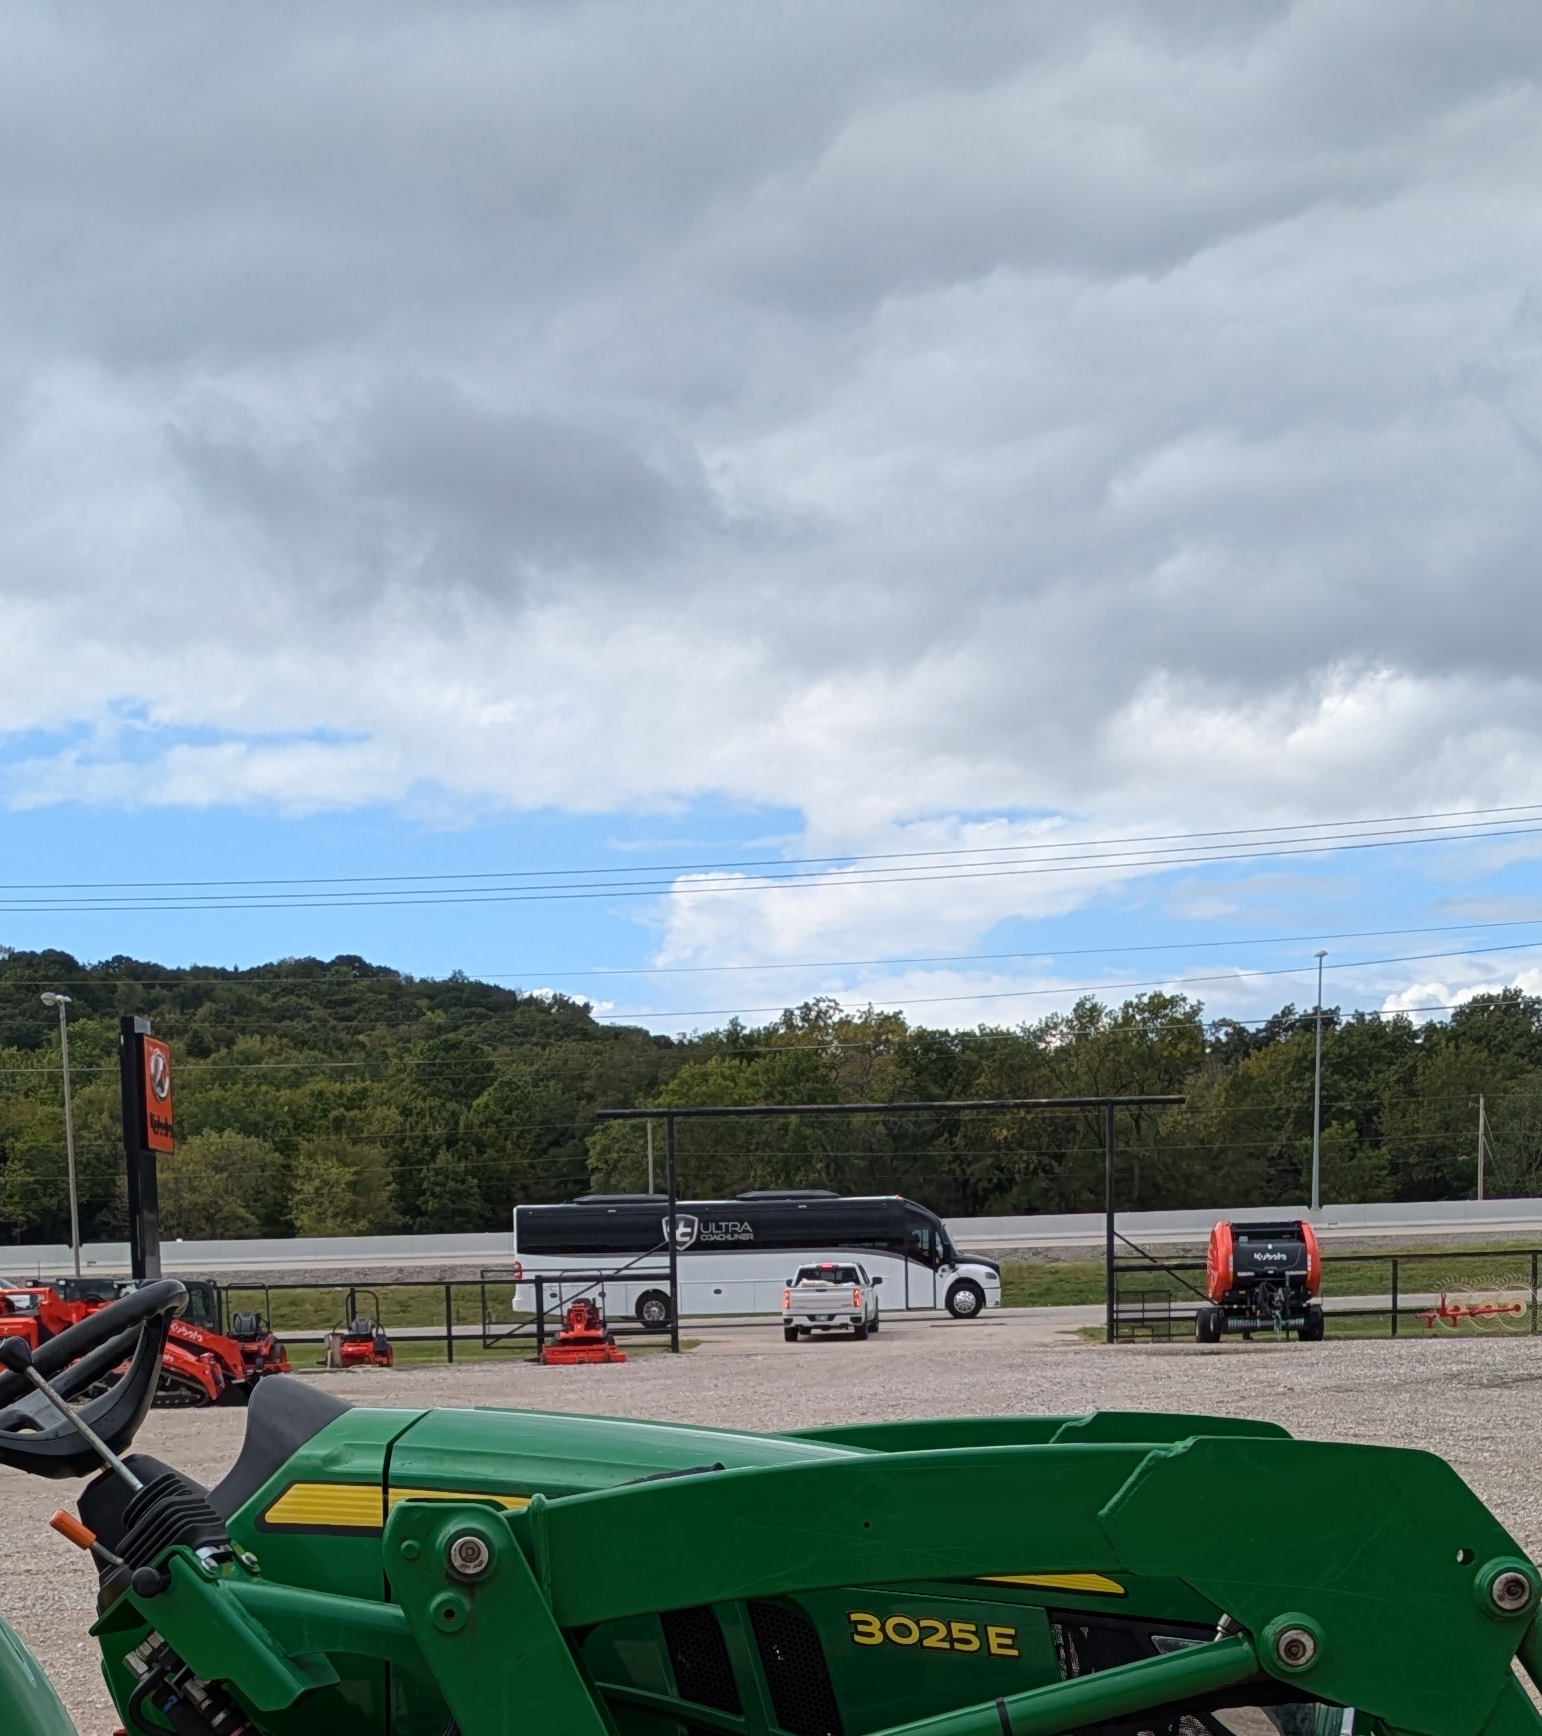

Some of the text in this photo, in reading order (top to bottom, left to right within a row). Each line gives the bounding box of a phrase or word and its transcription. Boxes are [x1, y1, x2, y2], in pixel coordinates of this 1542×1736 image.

[700, 1222, 752, 1233] ULTRA
[700, 1233, 754, 1241] COACHLINER
[1254, 1251, 1287, 1261] Kubota
[170, 1322, 204, 1343] Kubota
[847, 1611, 1020, 1659] 3025E
